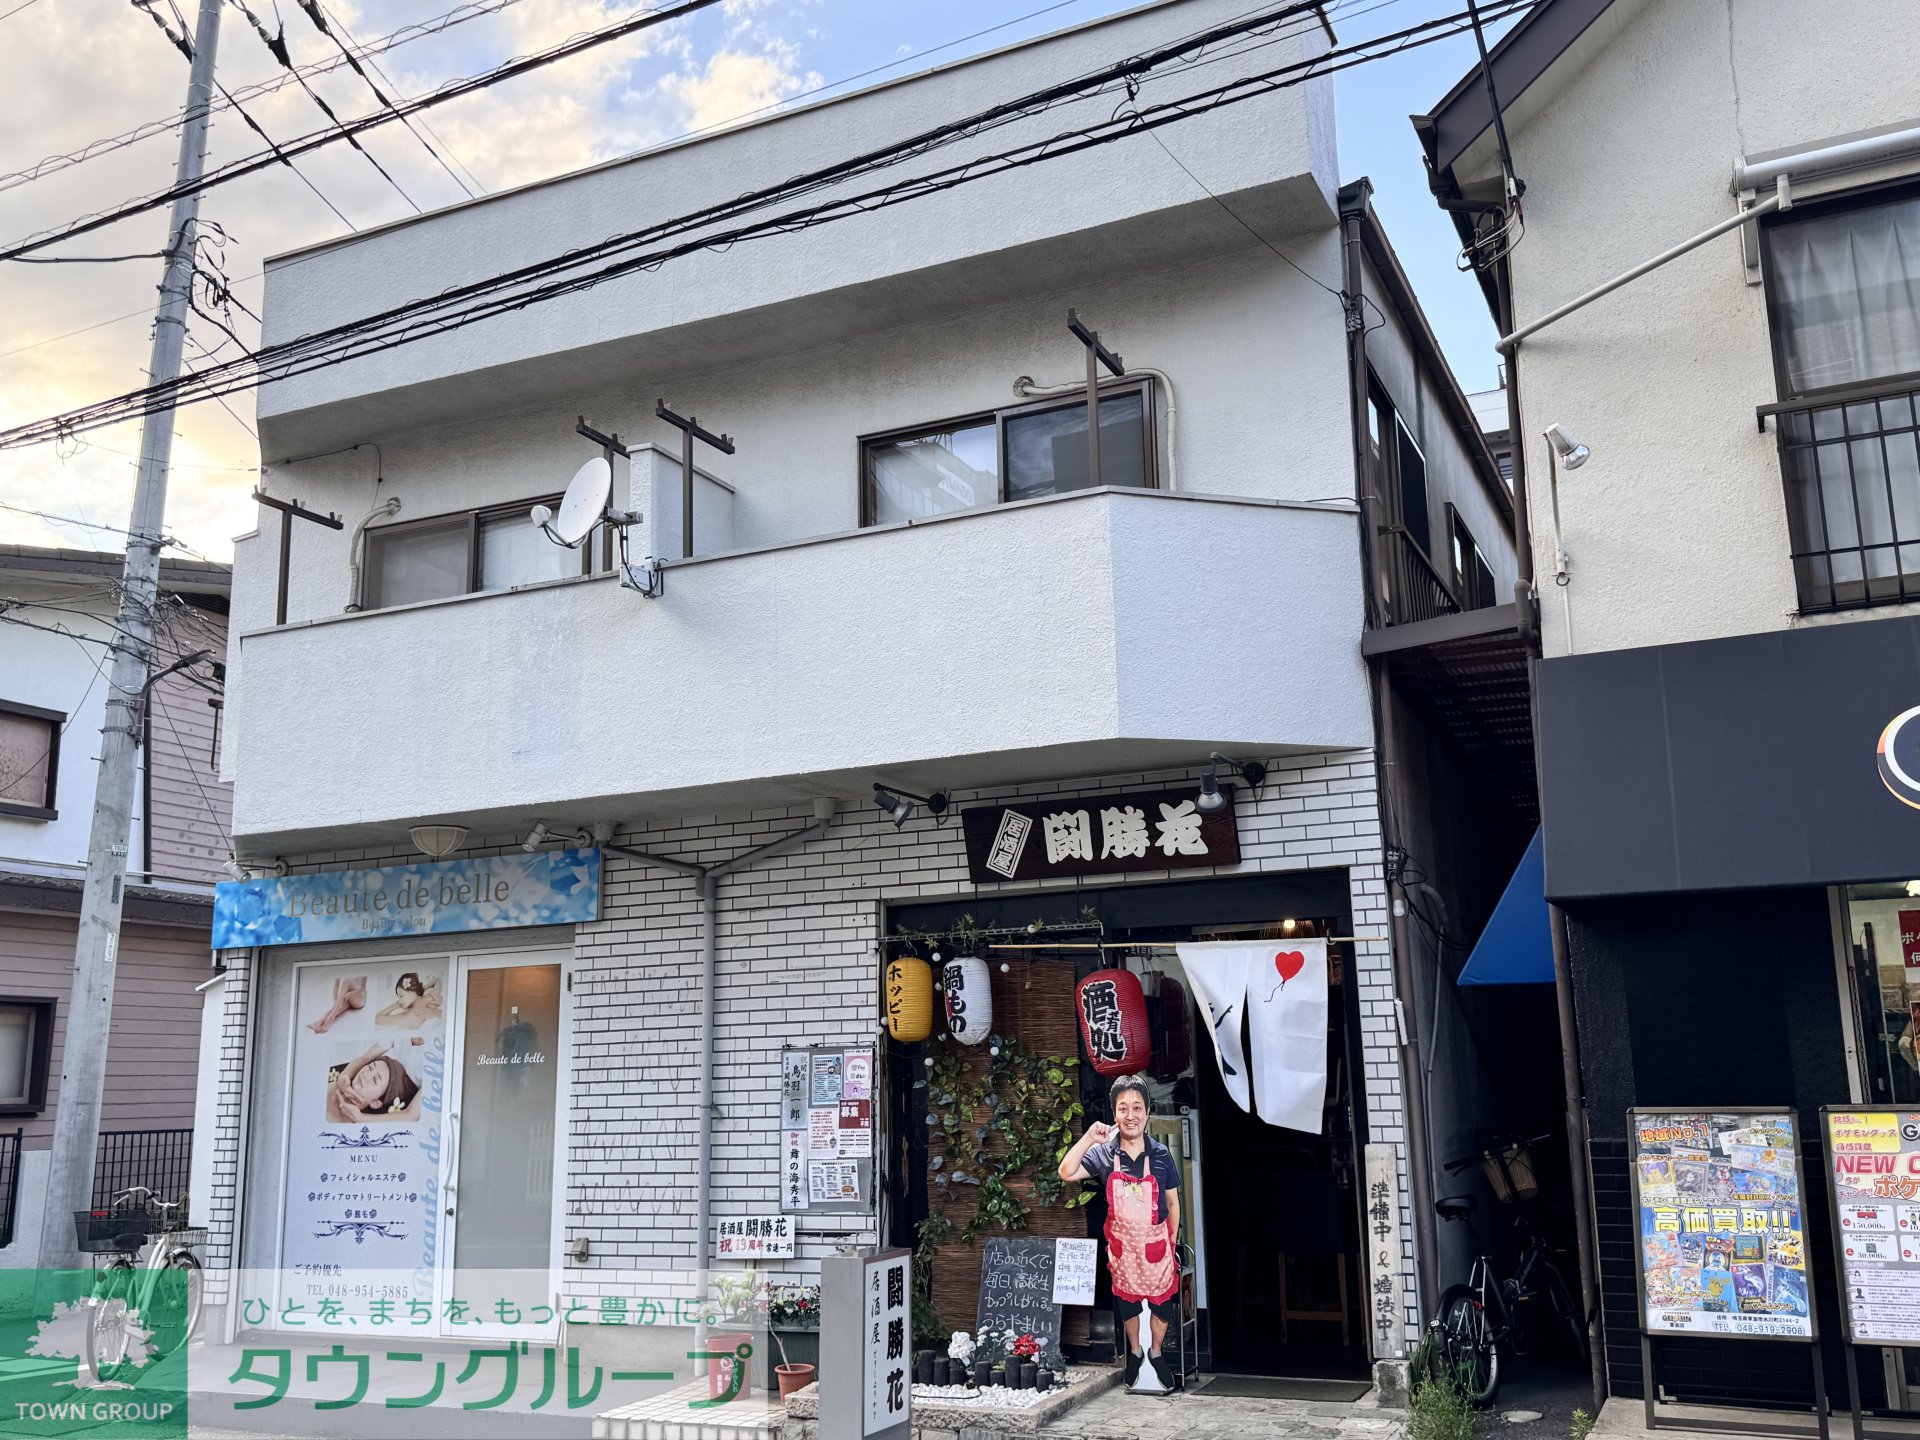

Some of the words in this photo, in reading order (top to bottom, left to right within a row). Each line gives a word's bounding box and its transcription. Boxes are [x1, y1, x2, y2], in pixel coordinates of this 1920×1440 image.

[993, 817, 1026, 870] 居酒屋
[289, 888, 388, 918] Beaute
[396, 878, 430, 910] de
[438, 872, 510, 906] belle
[888, 965, 903, 1032] ホッピー
[944, 964, 967, 1034] 鍋もの
[477, 1054, 508, 1066] Beaute
[510, 1052, 522, 1064] de
[523, 1051, 545, 1064] belle
[790, 1063, 802, 1122] 鳥羽一郎
[841, 1106, 859, 1118] 募集
[1639, 1123, 1709, 1144] 地域No.1
[349, 1154, 379, 1164] MENU
[1836, 1155, 1897, 1174] NEW
[330, 1173, 398, 1182] フェイシャルエステ
[789, 1148, 800, 1208] 舞の海秀平
[1369, 1182, 1392, 1243] 準備中
[1652, 1206, 1792, 1235] 高価買取!!
[719, 1221, 744, 1236] 居酒屋
[719, 1238, 733, 1253] 祝
[306, 1284, 325, 1296] TEL
[328, 1283, 409, 1299] 048-954-5885
[1736, 1324, 1803, 1335] 048-919-2908
